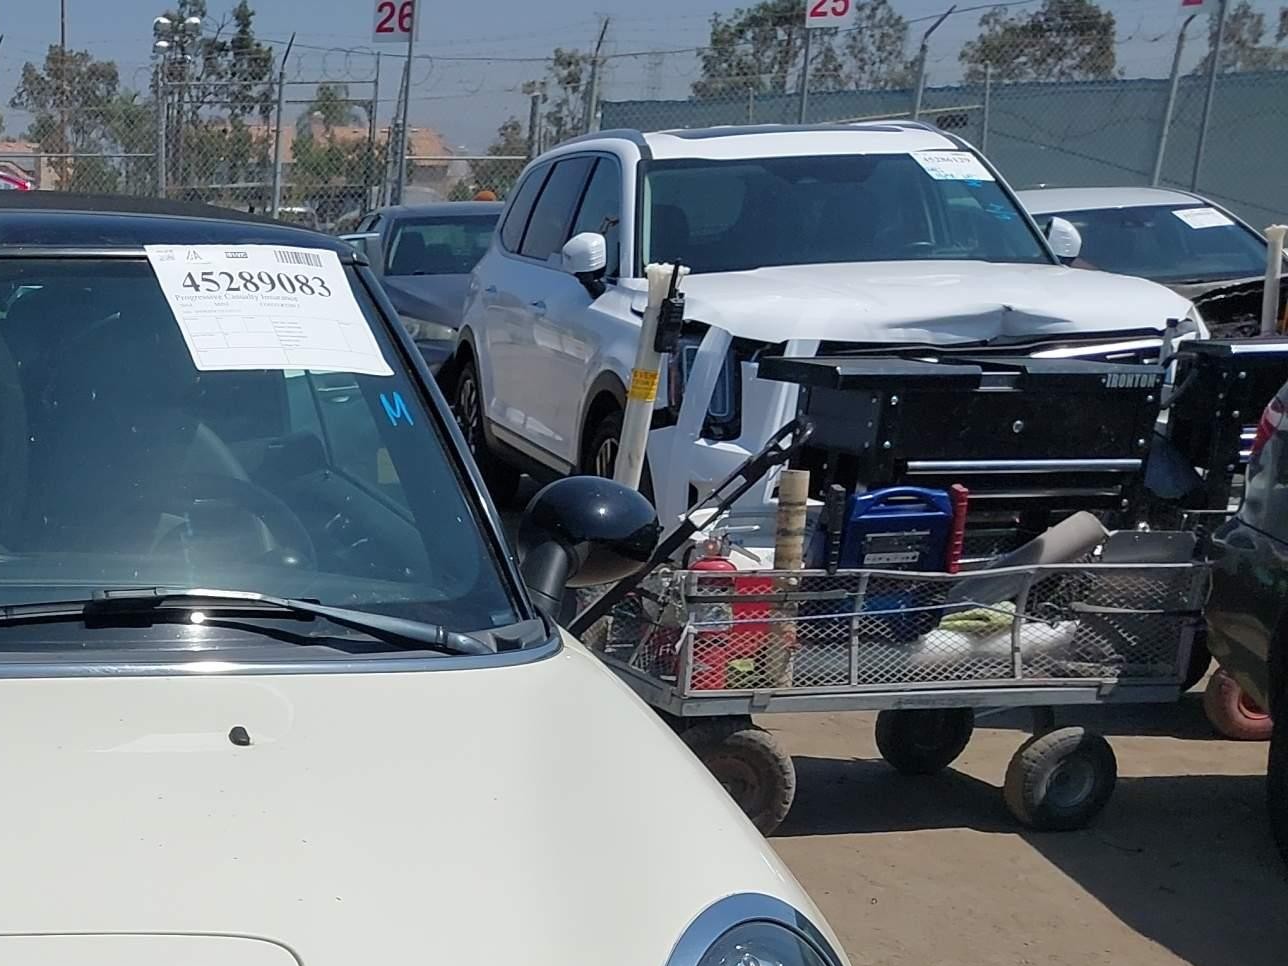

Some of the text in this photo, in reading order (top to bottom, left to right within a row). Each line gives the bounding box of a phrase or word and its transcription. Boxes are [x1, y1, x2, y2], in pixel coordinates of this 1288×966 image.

[375, 1, 413, 33] 26
[809, 0, 849, 17] 25
[182, 271, 331, 298] 45289083
[175, 294, 222, 302] Progressive
[224, 293, 258, 301] Casualty
[1105, 373, 1157, 388] IRONTON
[379, 391, 414, 426] M
